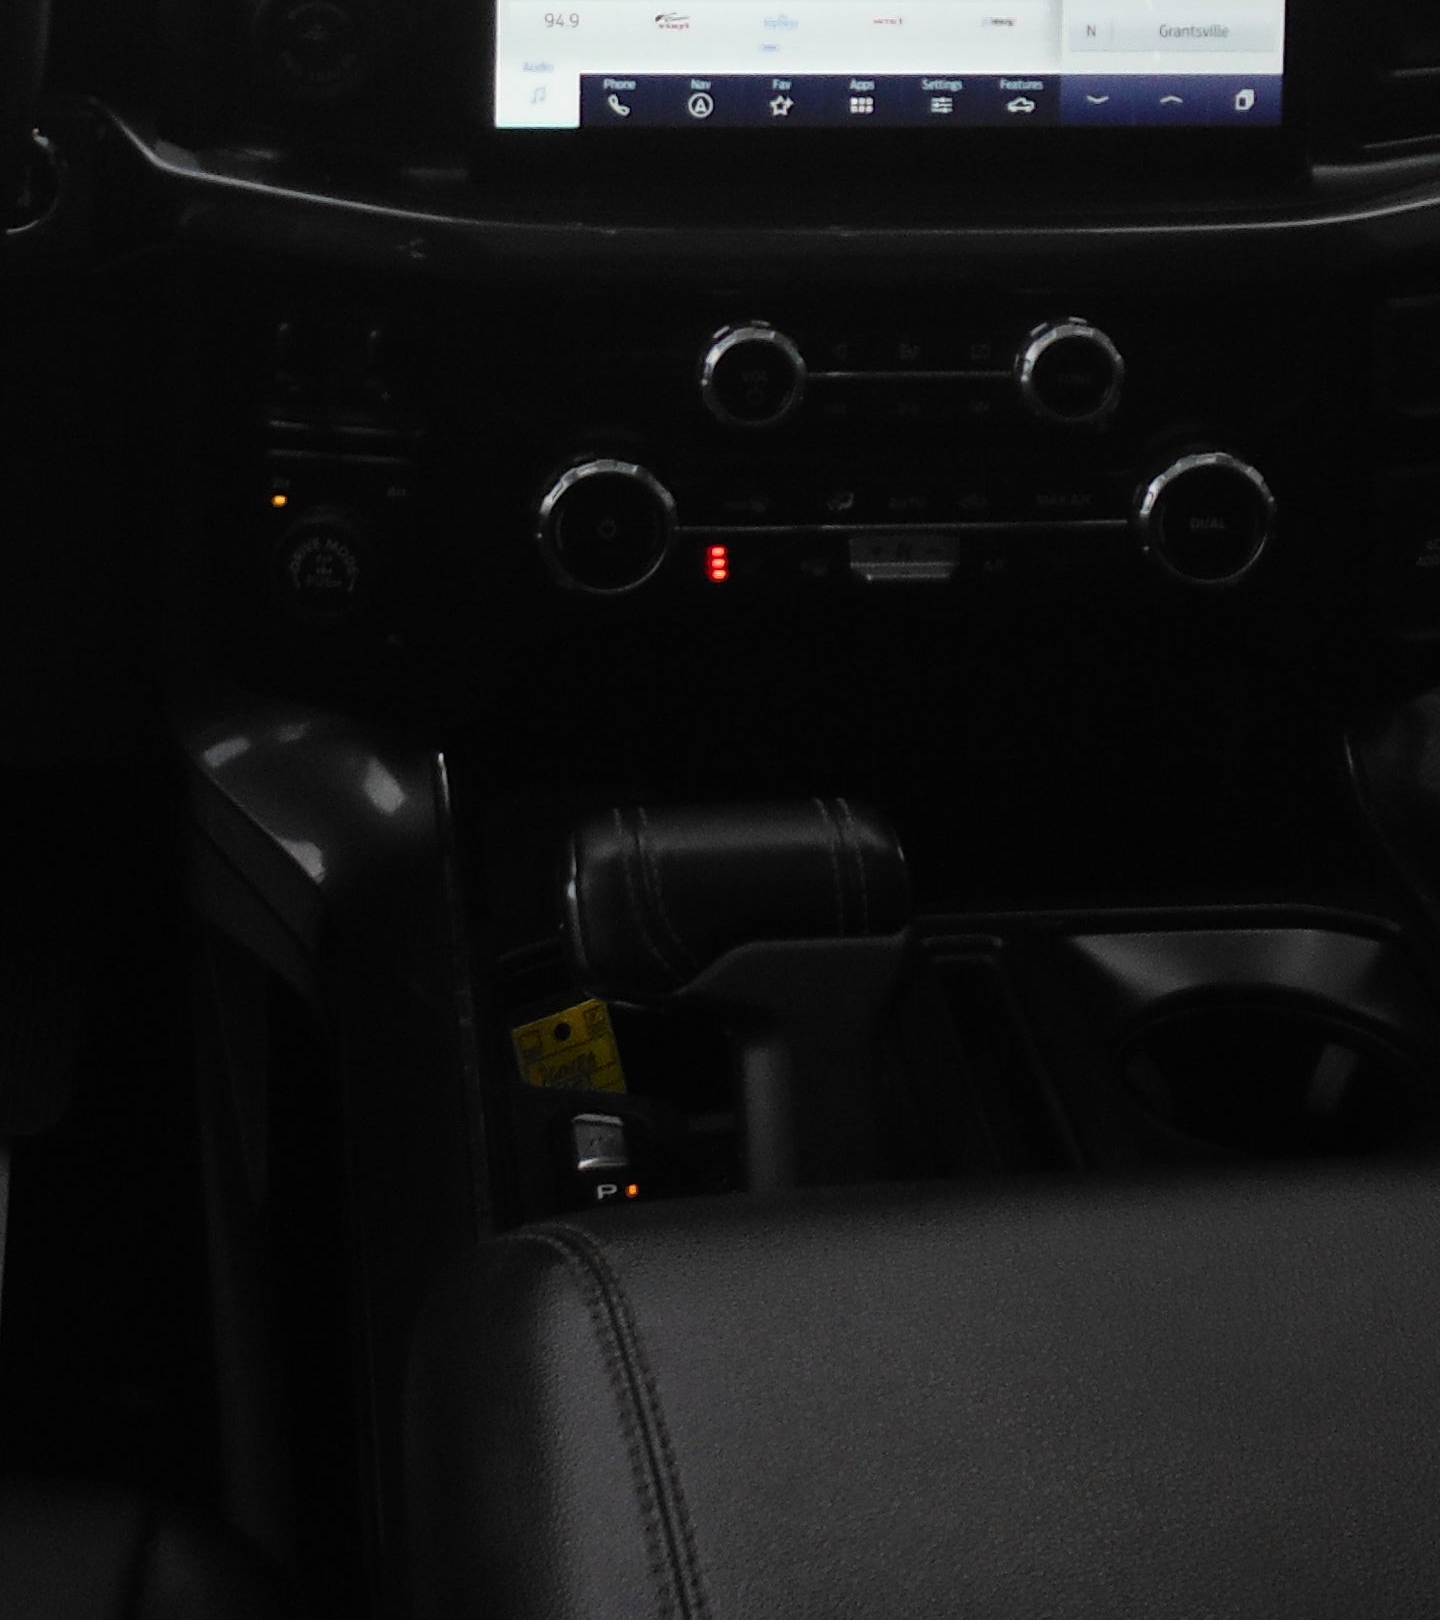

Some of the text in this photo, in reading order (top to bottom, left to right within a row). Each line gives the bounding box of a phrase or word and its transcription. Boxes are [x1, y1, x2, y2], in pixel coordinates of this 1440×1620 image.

[543, 12, 580, 29] 94.9
[1085, 25, 1097, 37] N
[1158, 24, 1230, 39] Grantsville
[602, 78, 637, 91] Phone
[690, 79, 712, 90] Nav
[772, 79, 792, 91] Fav
[849, 79, 876, 93] Apps
[921, 79, 964, 93] Settings
[999, 79, 1044, 91] Features
[597, 1183, 619, 1200] P
